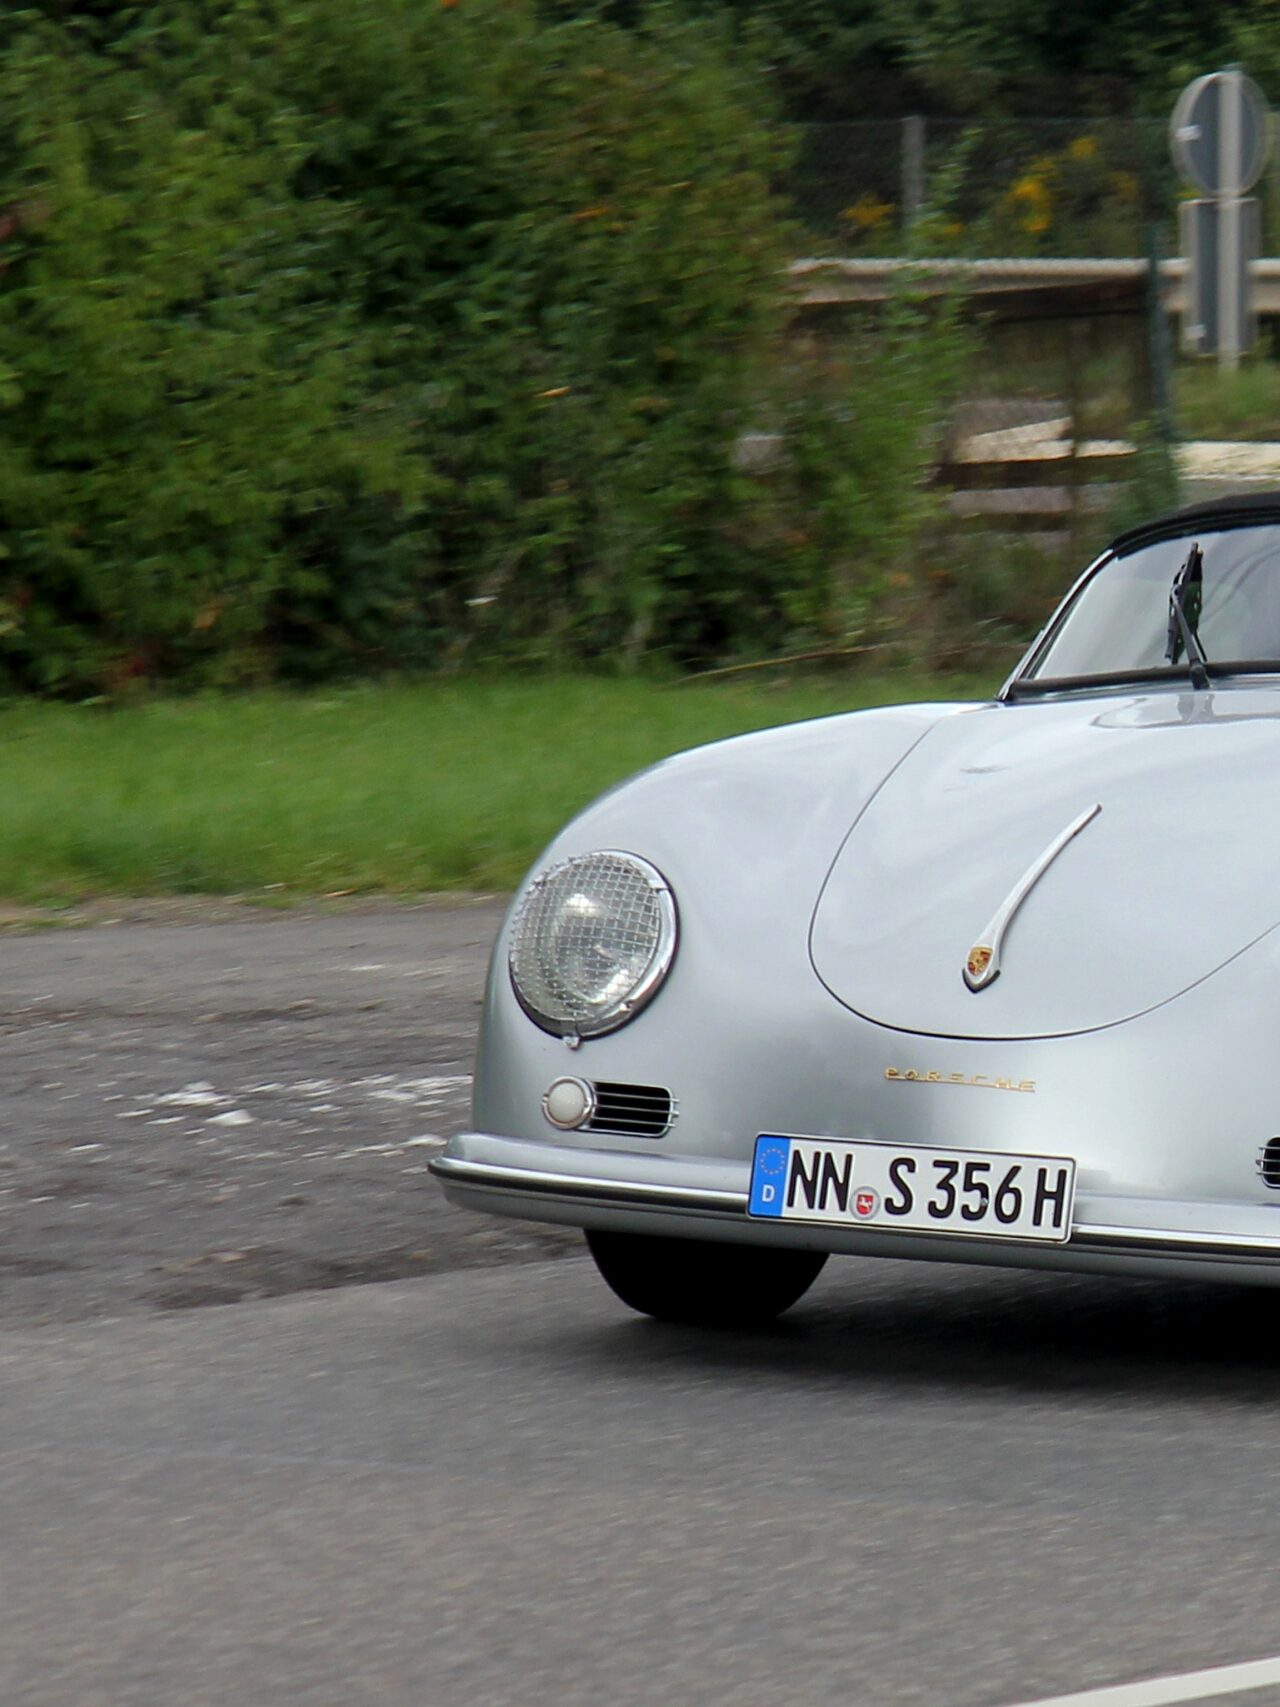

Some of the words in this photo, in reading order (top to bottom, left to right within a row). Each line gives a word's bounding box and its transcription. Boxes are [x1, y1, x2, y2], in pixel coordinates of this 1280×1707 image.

[885, 1066, 1036, 1092] PORSCHE
[761, 1185, 775, 1202] D
[787, 1149, 853, 1213] NN
[884, 1157, 917, 1216] S
